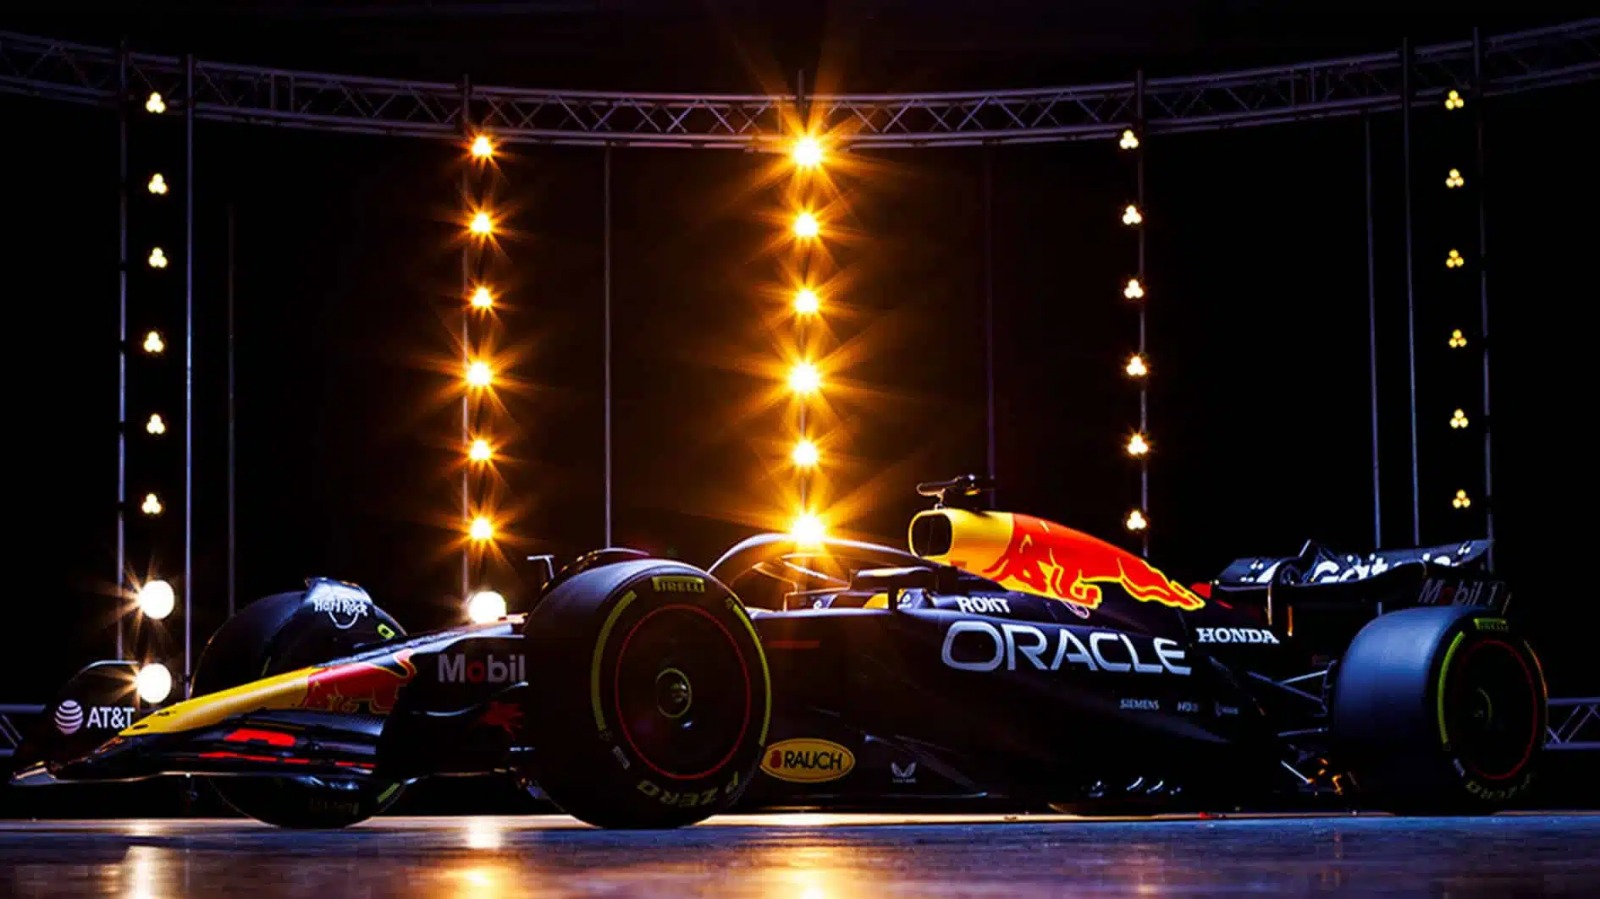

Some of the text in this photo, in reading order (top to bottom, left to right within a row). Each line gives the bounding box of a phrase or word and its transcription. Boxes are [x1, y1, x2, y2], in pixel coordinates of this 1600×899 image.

[1417, 578, 1484, 606] Mobil
[940, 620, 1193, 677] ORACLE
[1195, 627, 1281, 645] HONDA
[437, 653, 526, 684] Mobil
[86, 706, 136, 730] AT&T
[783, 750, 843, 769] RAUCH
